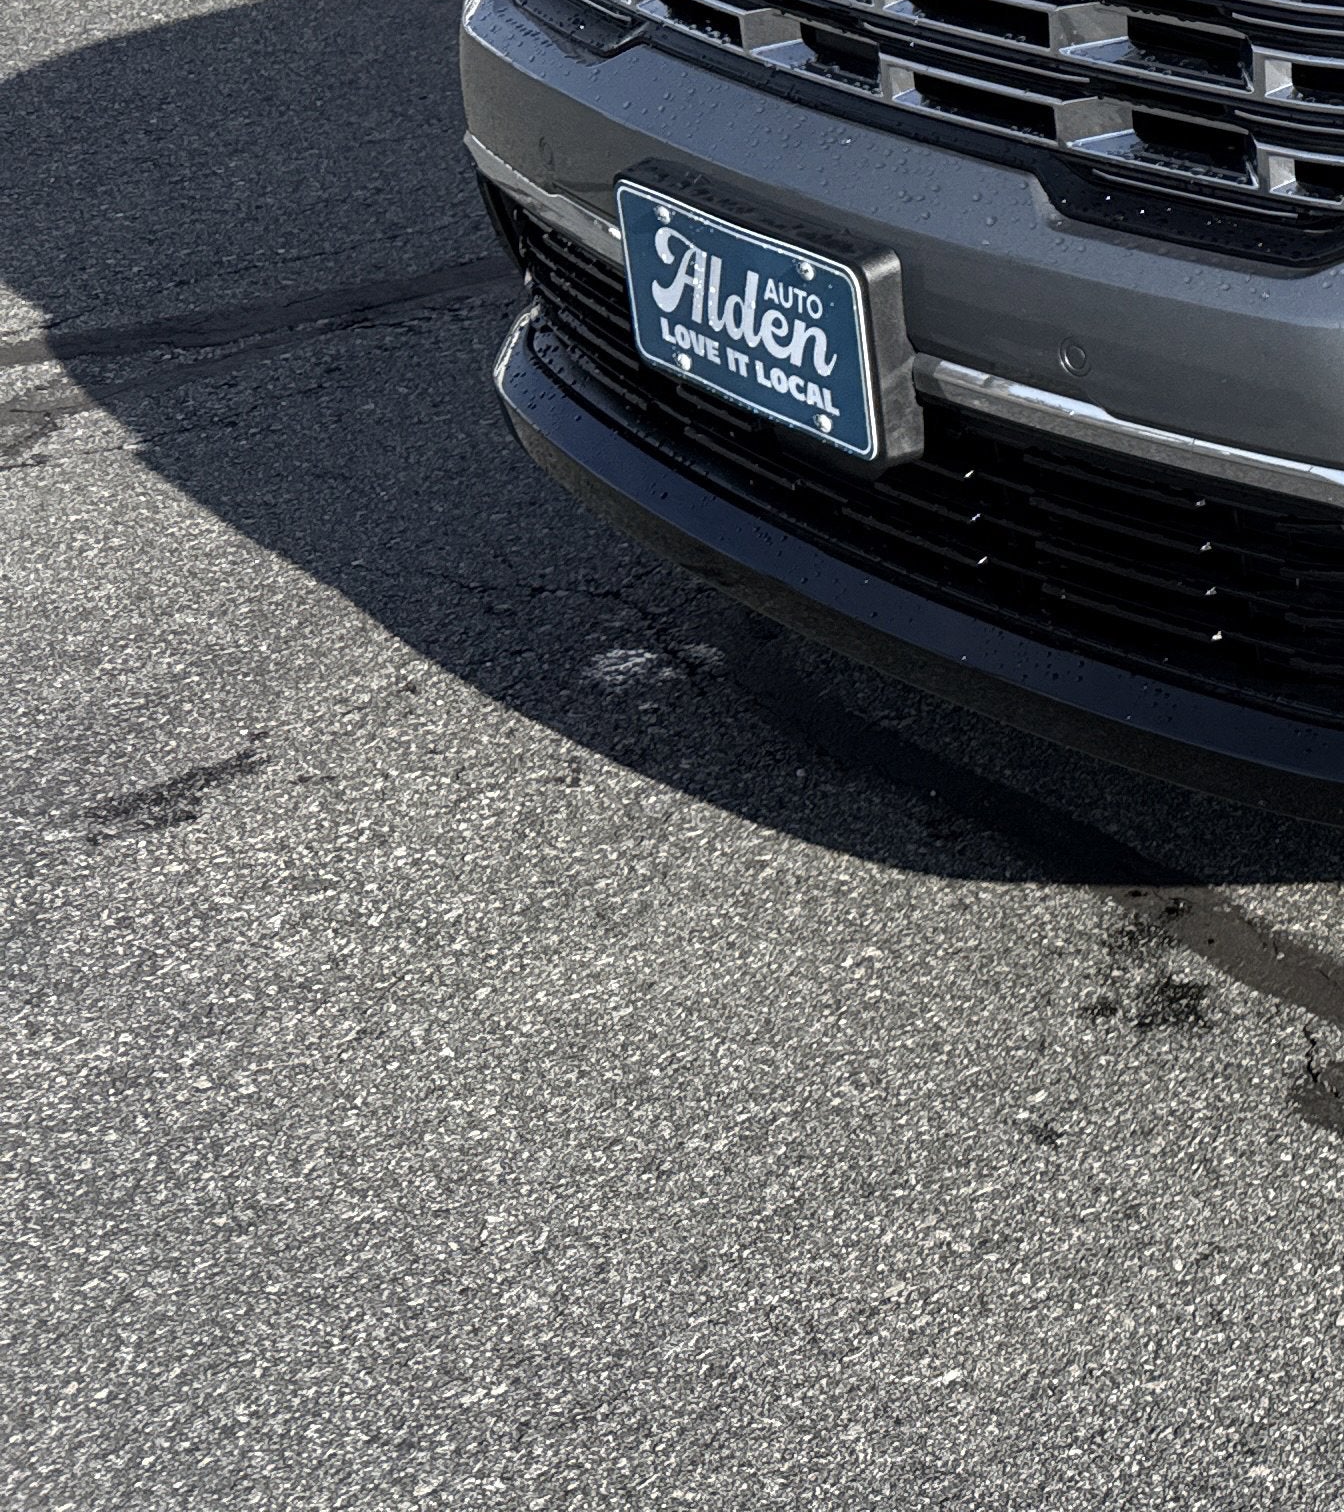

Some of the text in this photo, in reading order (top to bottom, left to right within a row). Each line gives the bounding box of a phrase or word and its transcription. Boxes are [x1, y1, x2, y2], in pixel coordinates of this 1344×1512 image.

[651, 226, 838, 378] Alden
[763, 277, 823, 320] AUTO
[660, 316, 841, 417] LOVE IT LOCAL
